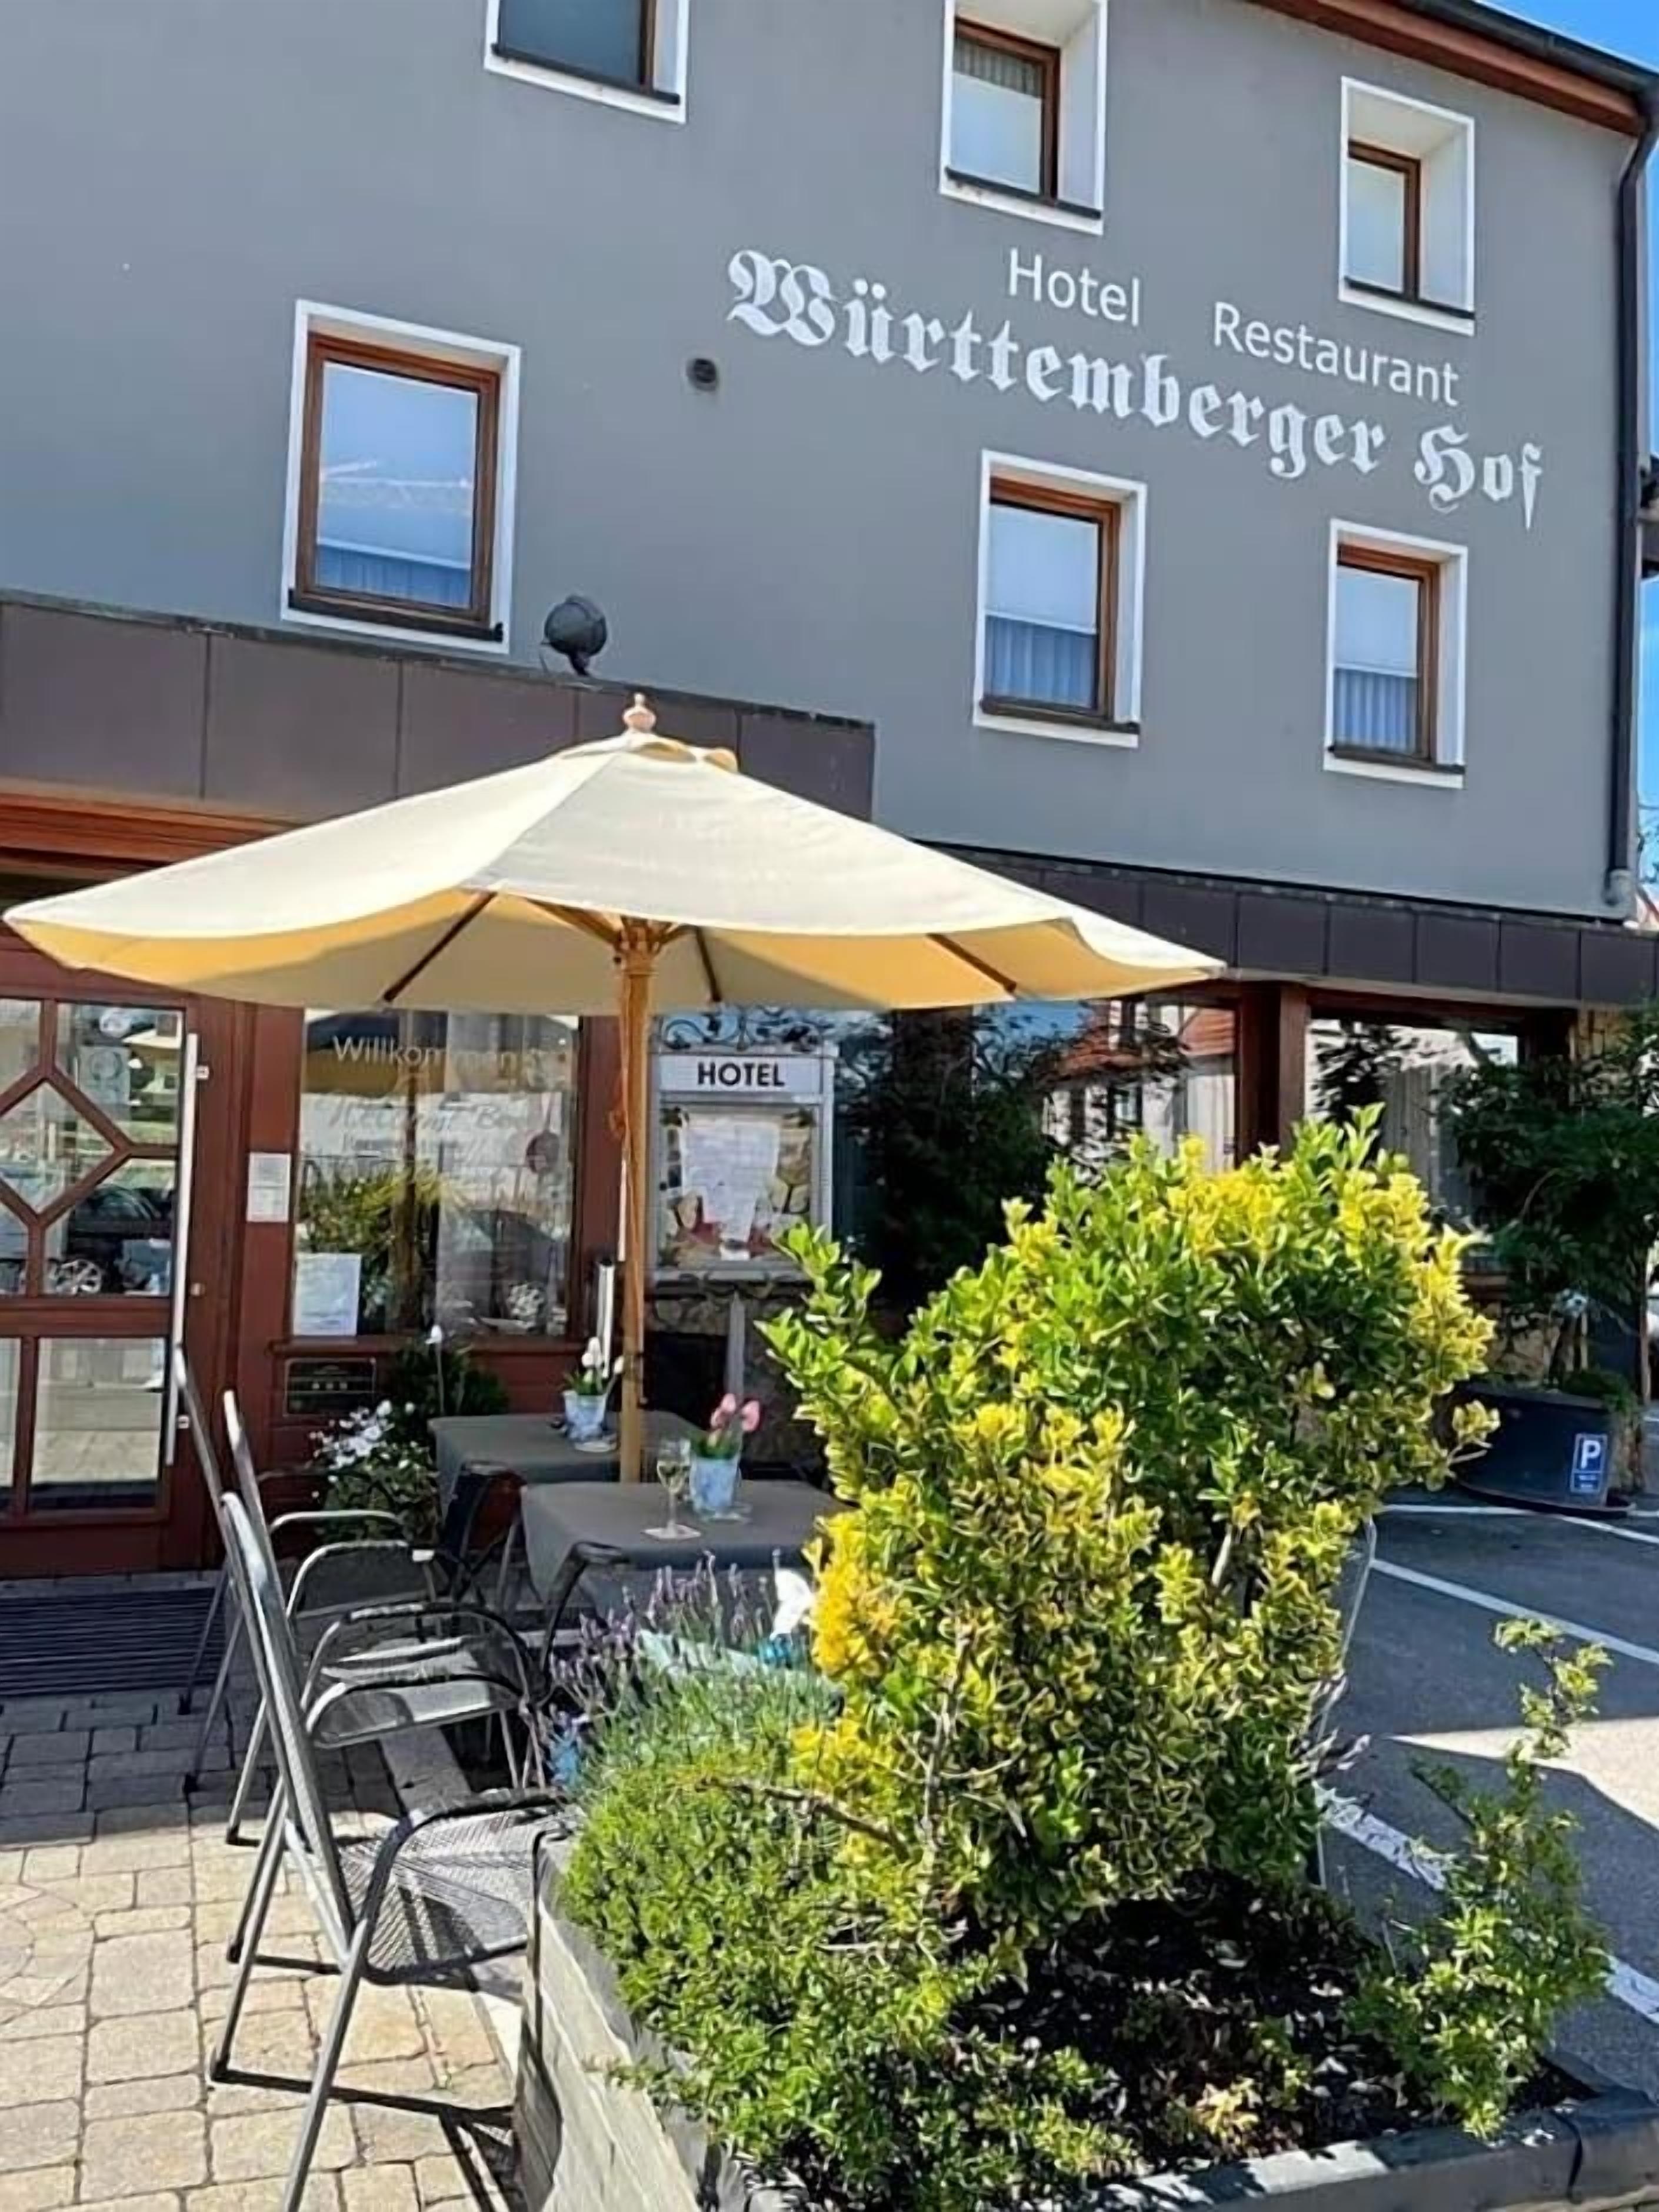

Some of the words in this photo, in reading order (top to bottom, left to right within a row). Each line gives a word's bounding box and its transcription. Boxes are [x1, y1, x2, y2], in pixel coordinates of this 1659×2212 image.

[1008, 247, 1140, 327] Hotel
[1213, 301, 1460, 407] Restaurant
[726, 249, 1386, 478] Württemberger
[1414, 424, 1543, 531] Hof
[333, 1035, 518, 1071] Willkomn
[697, 1061, 785, 1087] HOTEL
[1581, 1440, 1601, 1468] P
